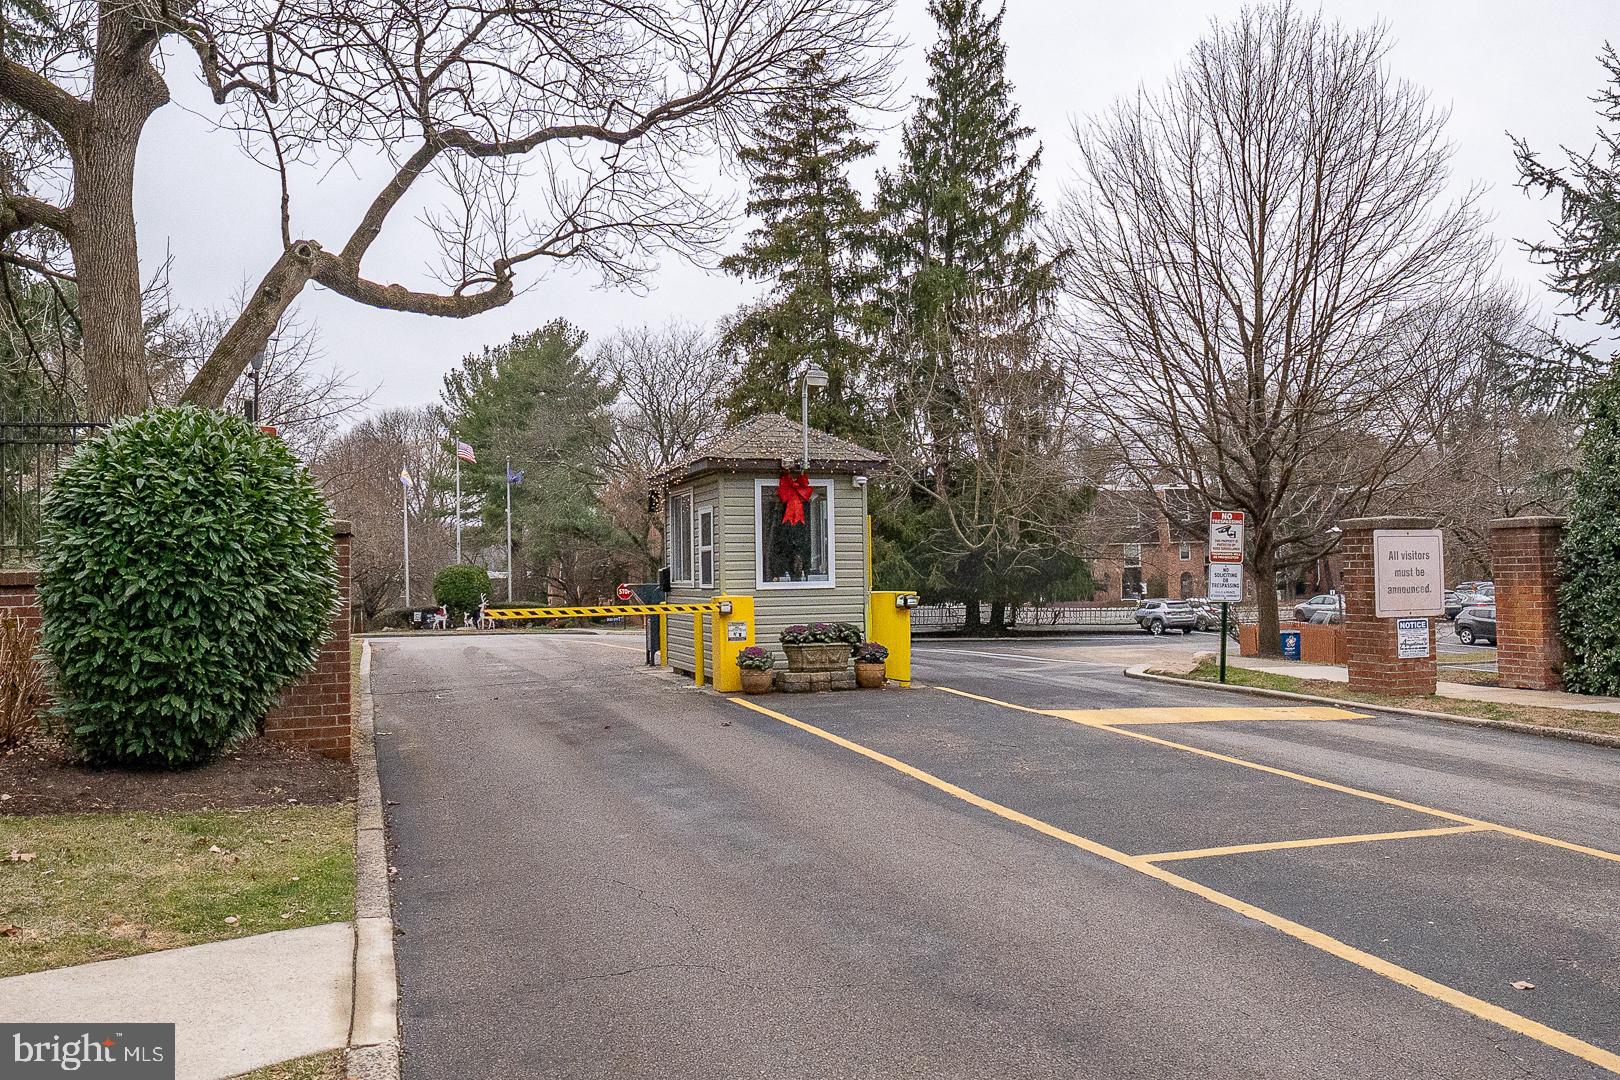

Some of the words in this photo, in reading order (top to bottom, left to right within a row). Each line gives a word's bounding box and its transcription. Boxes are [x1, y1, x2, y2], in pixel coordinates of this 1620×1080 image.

[1388, 550, 1399, 561] All
[1400, 550, 1431, 561] visitors
[1394, 567, 1414, 577] must
[1415, 566, 1425, 577] be
[1387, 584, 1432, 595] announced.
